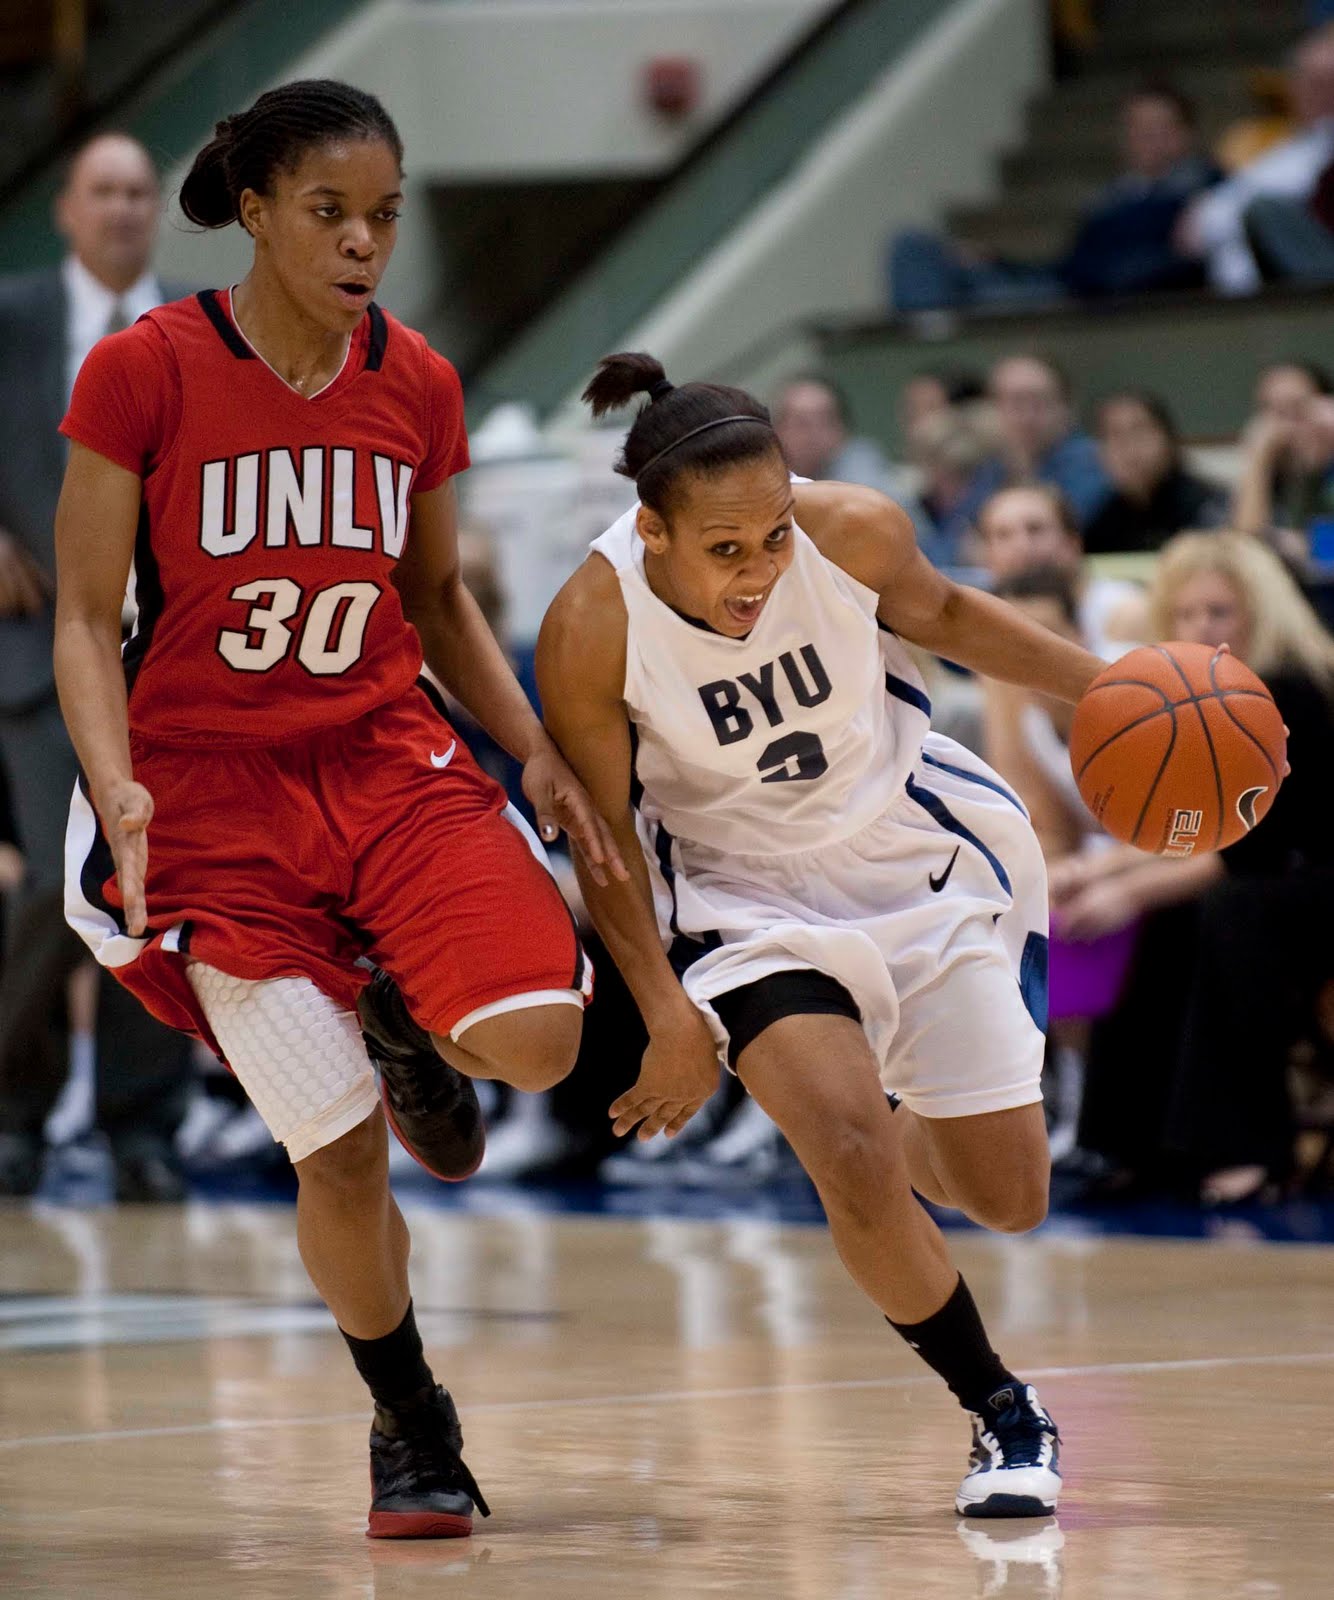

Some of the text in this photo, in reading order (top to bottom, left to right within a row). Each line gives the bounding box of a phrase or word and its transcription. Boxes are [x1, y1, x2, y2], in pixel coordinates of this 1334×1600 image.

[199, 445, 415, 561] UNLV
[216, 576, 384, 677] 30
[698, 643, 832, 746] BYU
